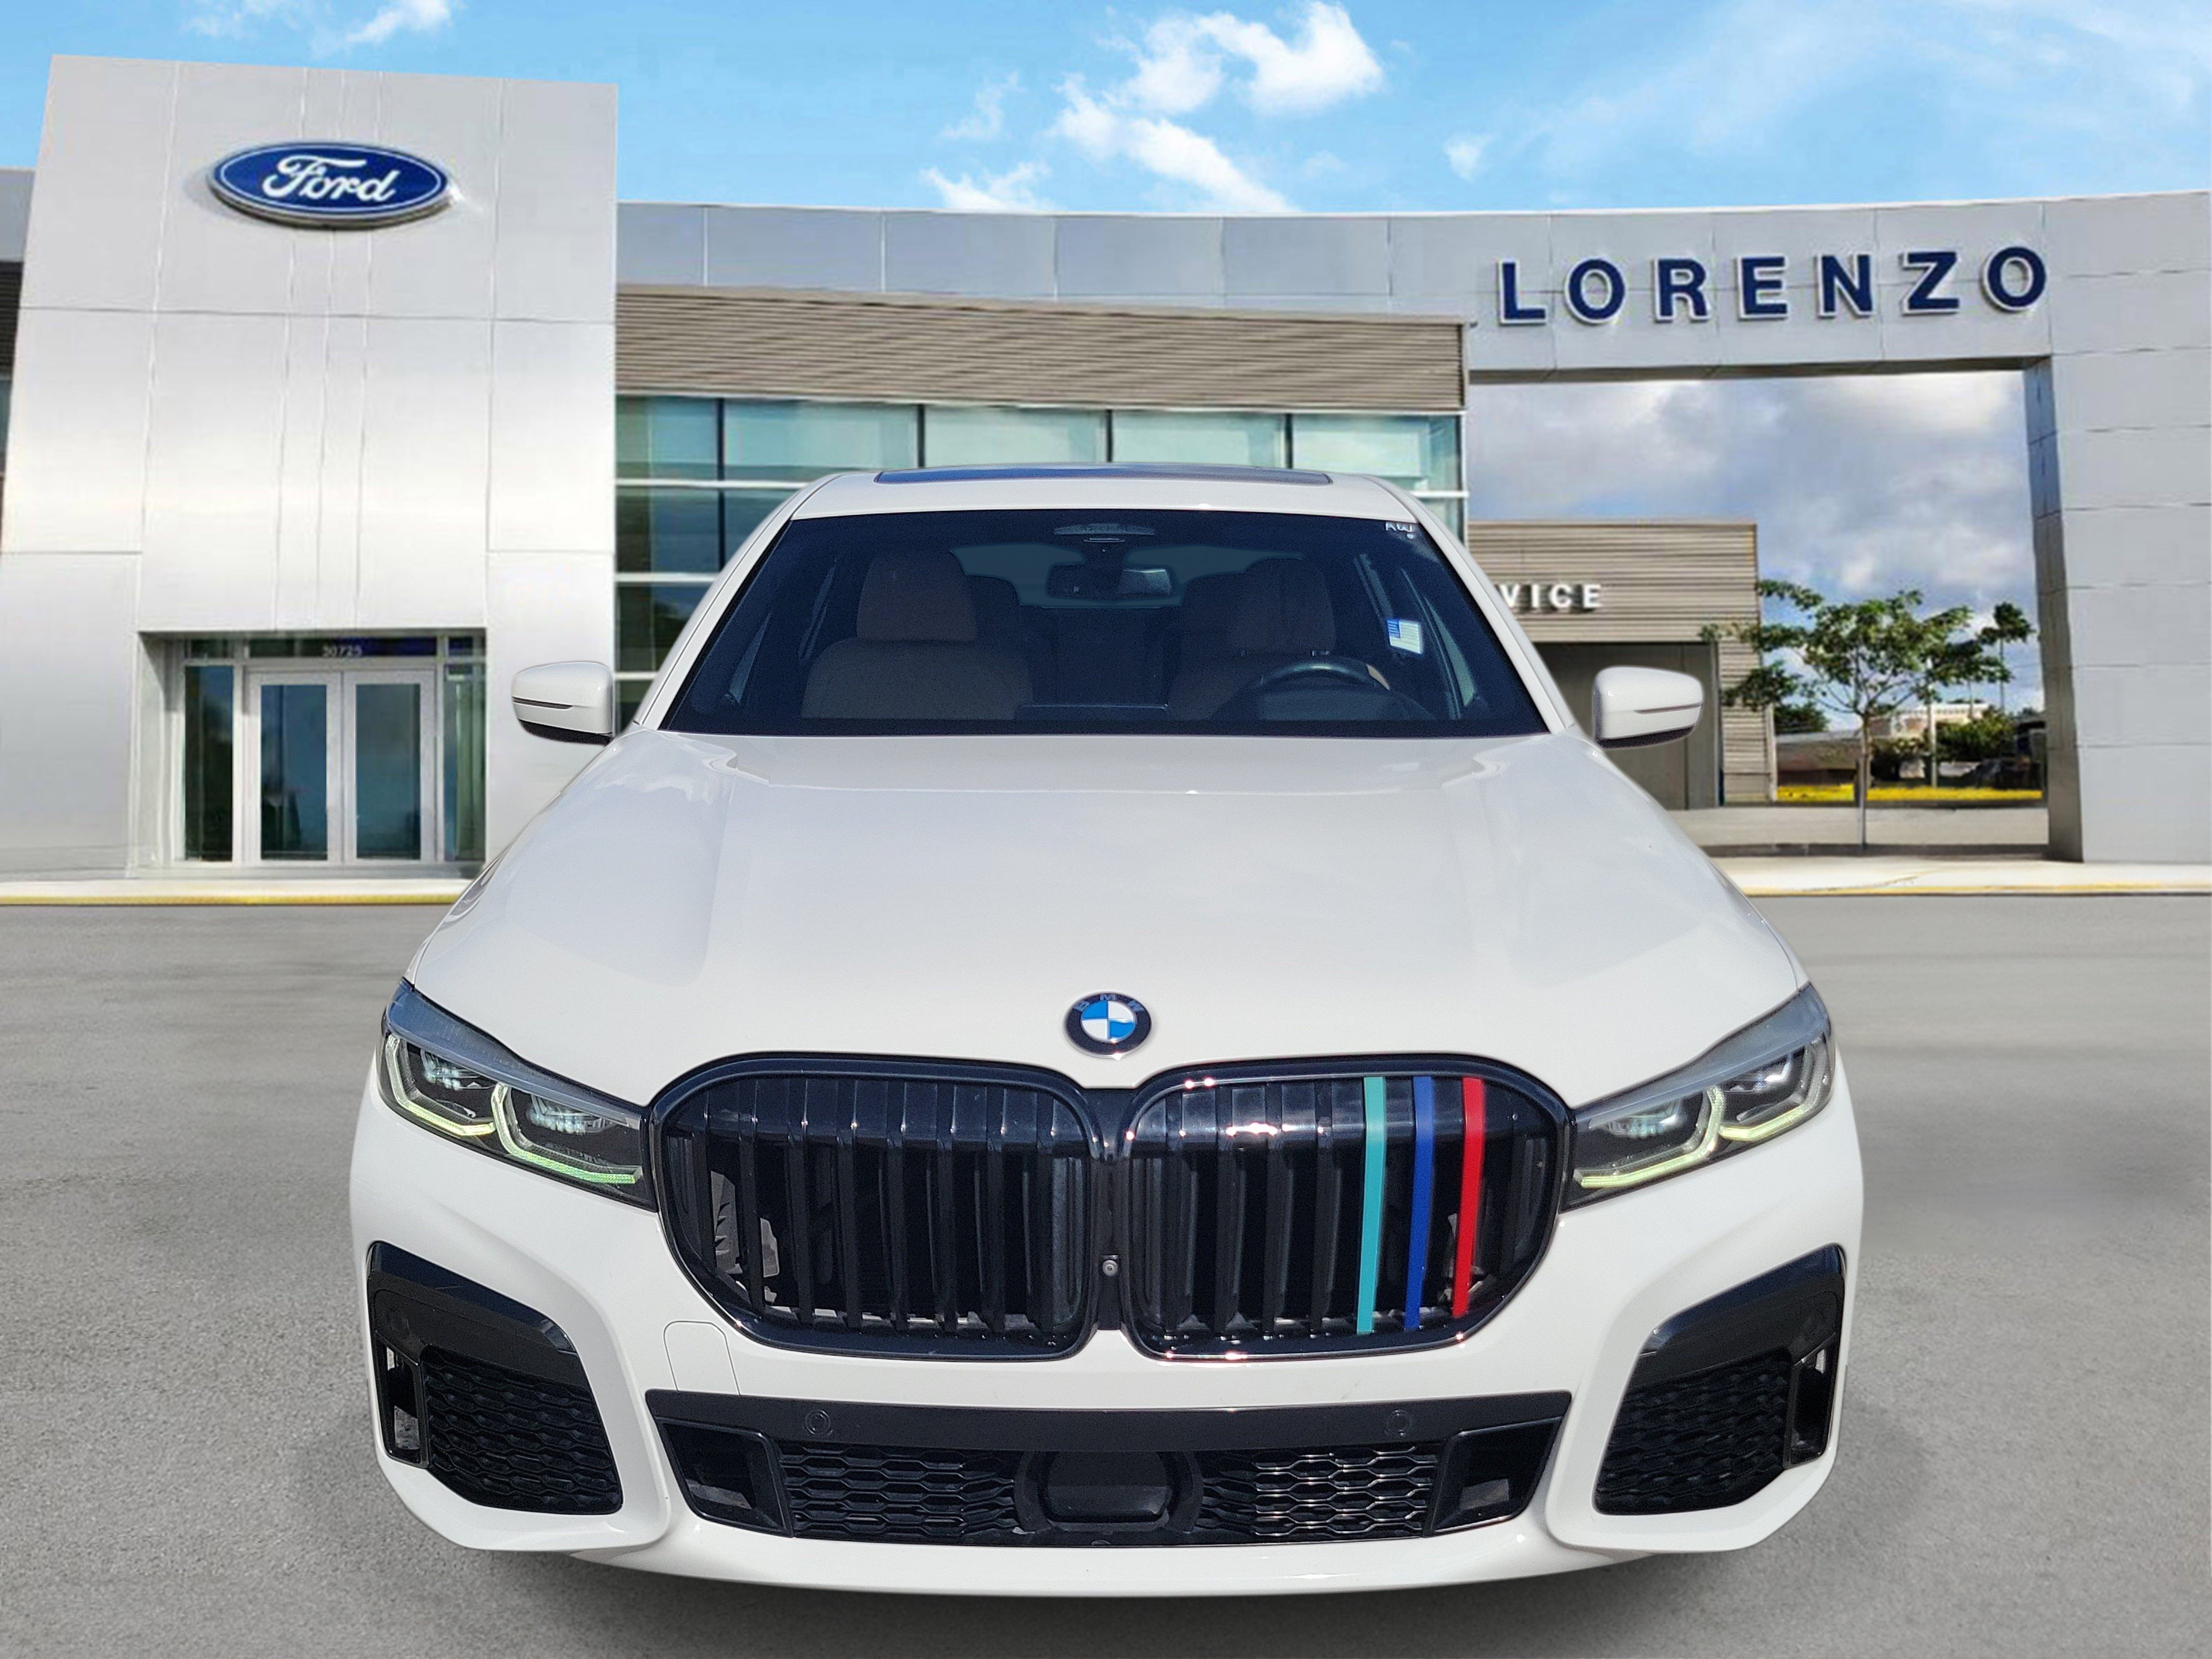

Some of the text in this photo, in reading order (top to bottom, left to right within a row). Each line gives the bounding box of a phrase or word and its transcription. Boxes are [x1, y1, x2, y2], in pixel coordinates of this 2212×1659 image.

[262, 154, 400, 201] Ford
[1500, 246, 2046, 325] LORENZO
[1073, 993, 1145, 1012] BMW
